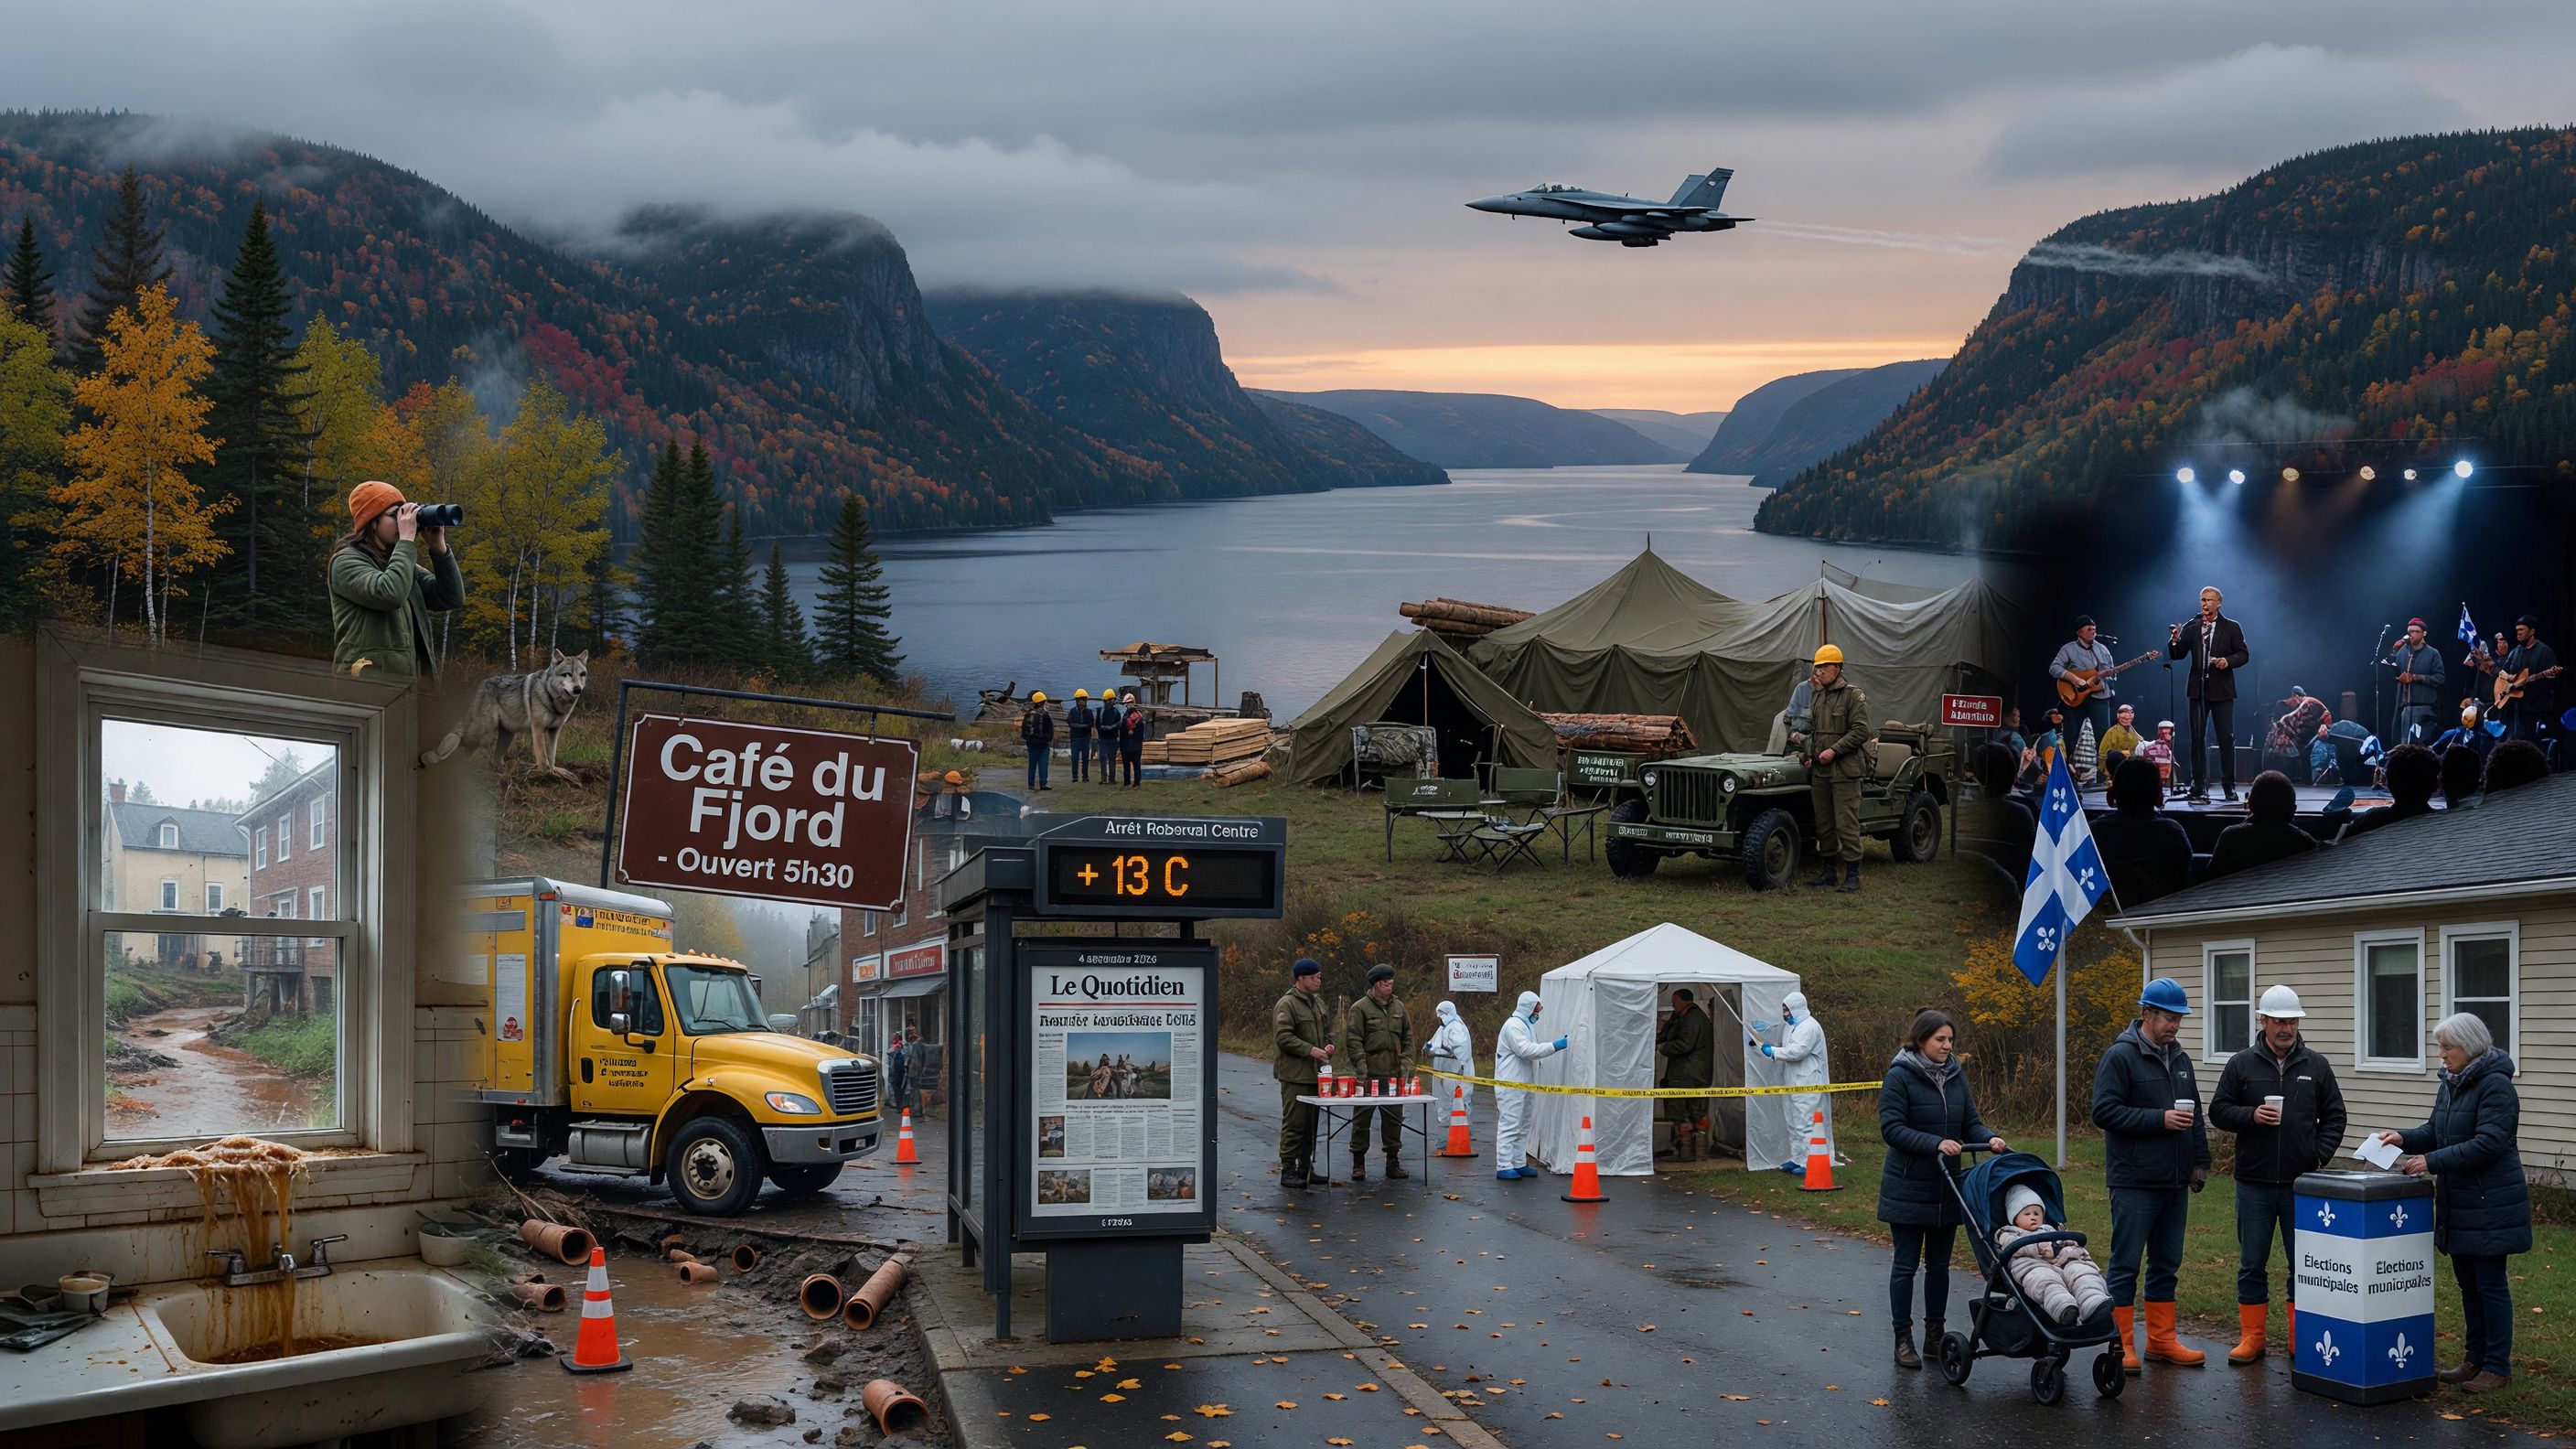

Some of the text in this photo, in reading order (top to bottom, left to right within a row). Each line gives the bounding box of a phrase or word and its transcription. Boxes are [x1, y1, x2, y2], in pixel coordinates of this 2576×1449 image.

[660, 734, 886, 801] Café du
[690, 787, 845, 850] Fjord
[1105, 821, 1142, 835] Arrêt
[1211, 824, 1259, 838] Centre
[677, 847, 776, 881] Ouvert
[784, 859, 854, 889] 5h30
[1111, 855, 1149, 896] 13
[1165, 856, 1188, 896] C
[1051, 974, 1186, 1000] Le Quotidien
[2304, 1251, 2352, 1274] Élections
[2298, 1273, 2358, 1294] municipales
